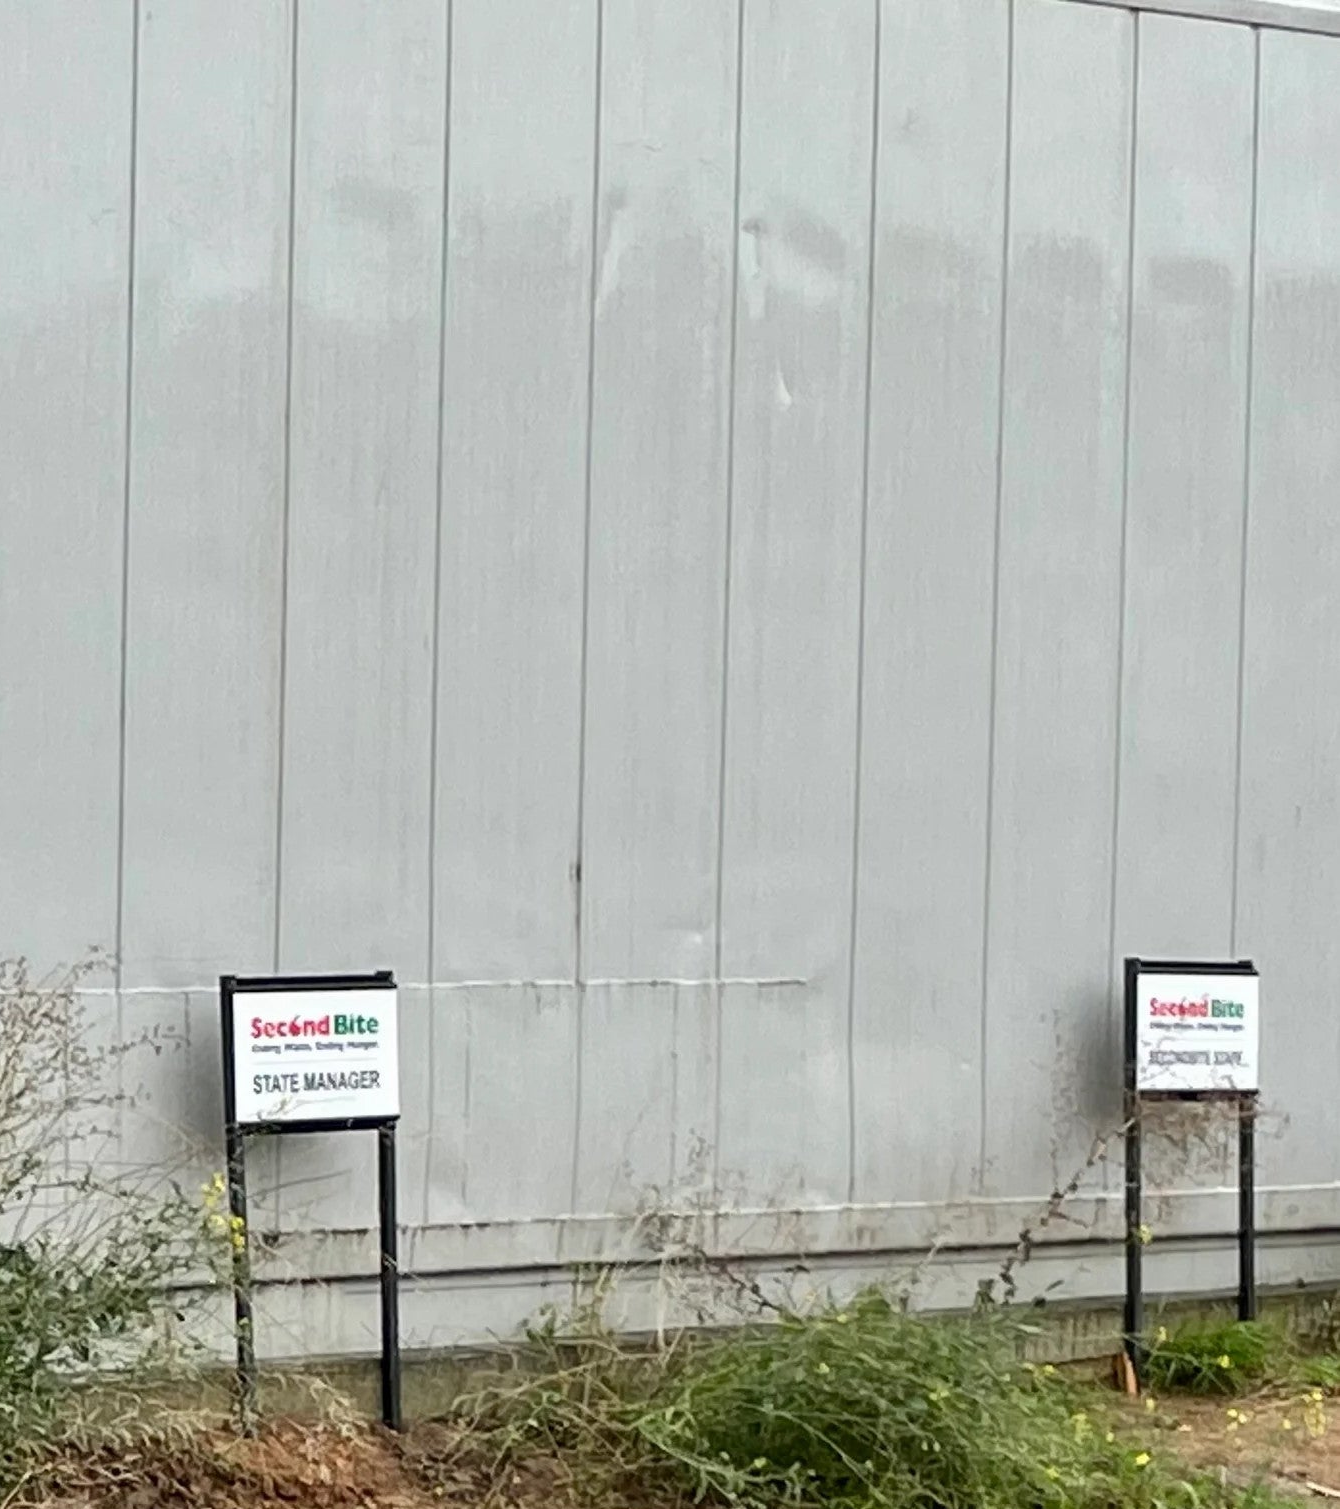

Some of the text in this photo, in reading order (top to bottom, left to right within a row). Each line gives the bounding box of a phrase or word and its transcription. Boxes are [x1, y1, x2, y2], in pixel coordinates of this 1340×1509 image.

[251, 1014, 379, 1038] SecondBite
[253, 1070, 380, 1095] STATE MANAGER
